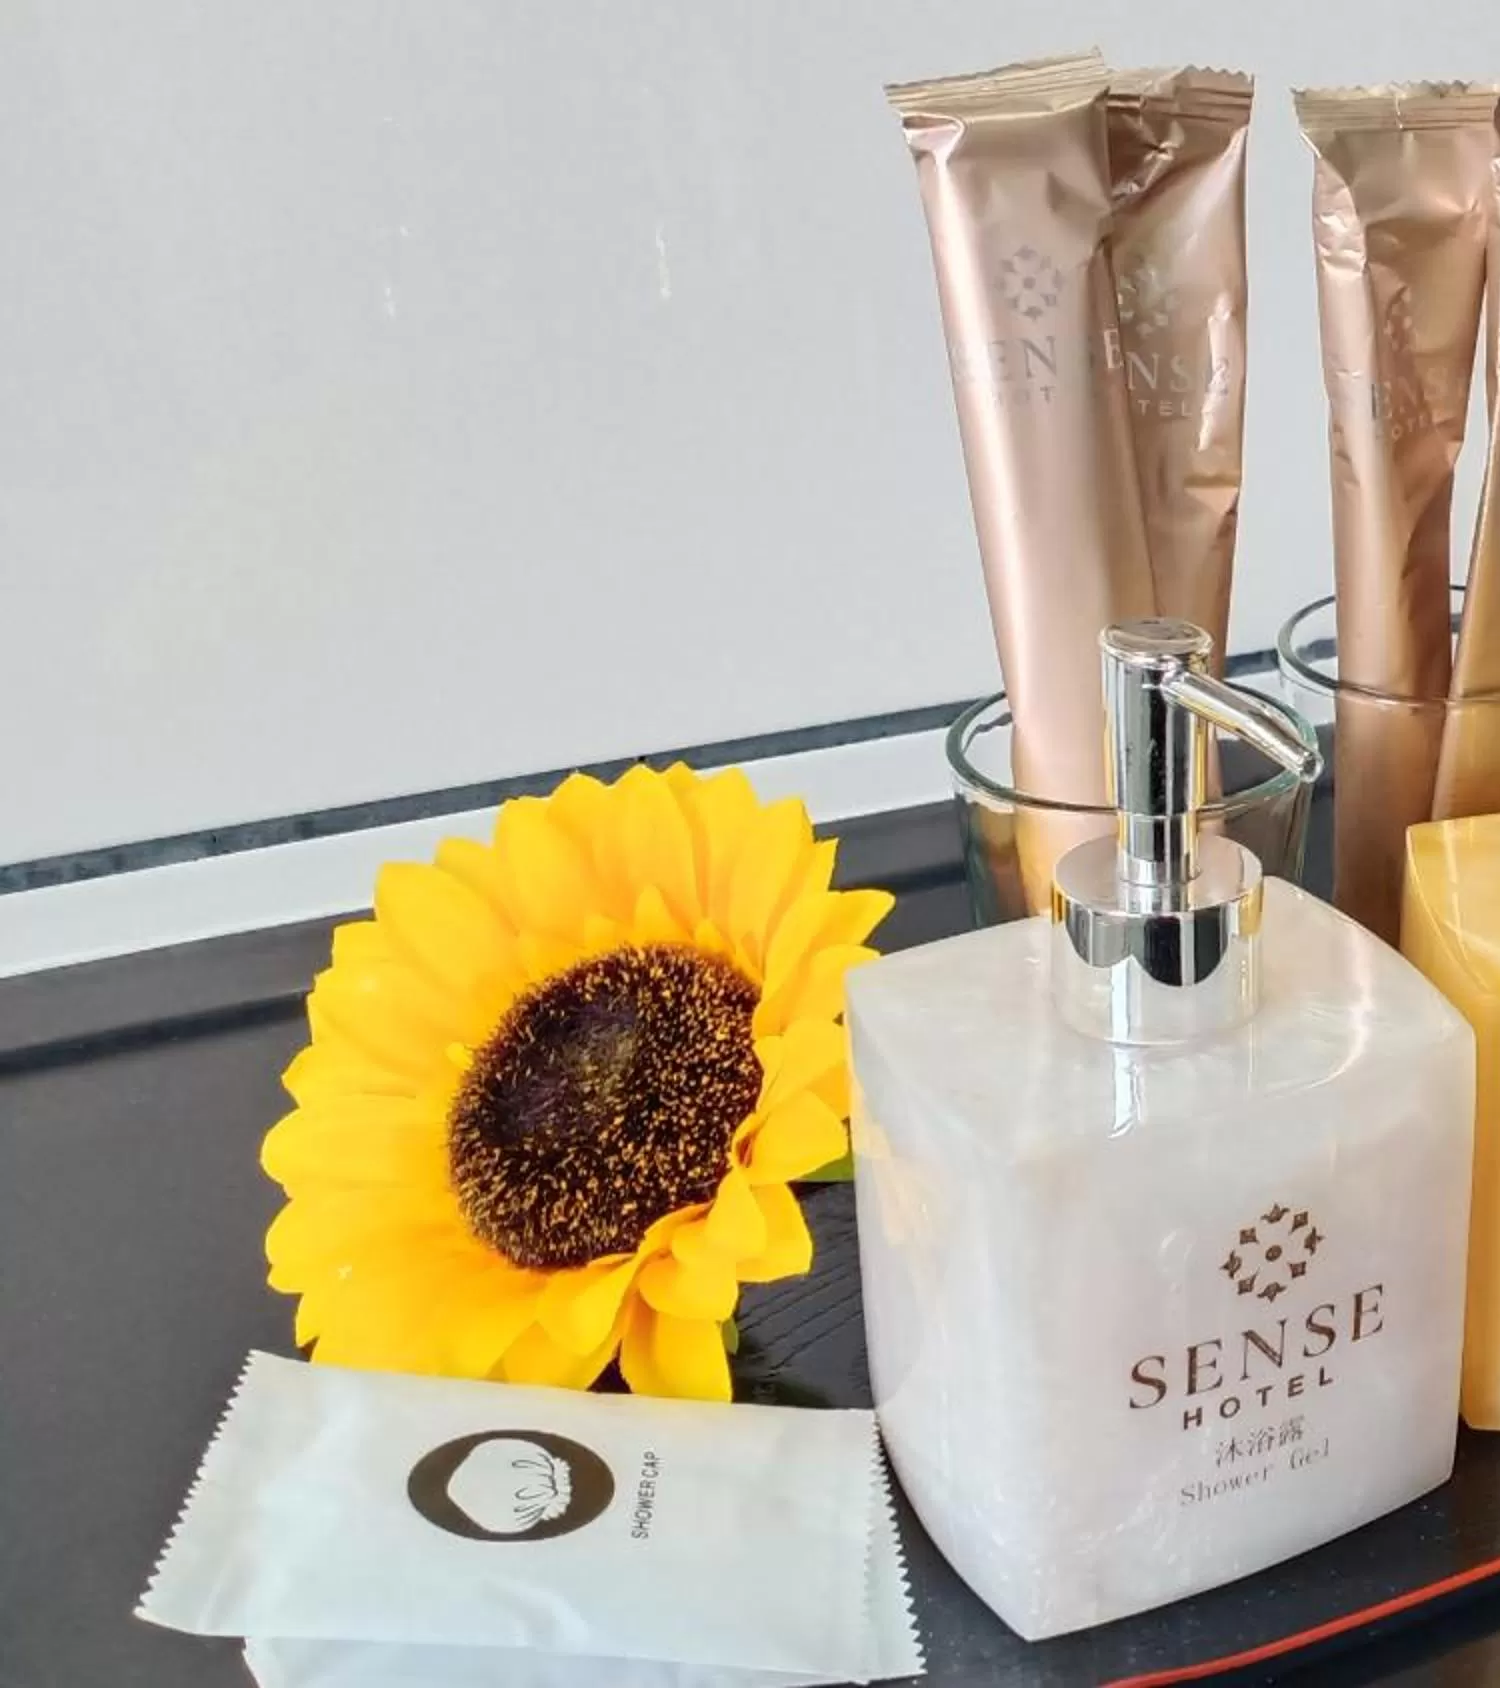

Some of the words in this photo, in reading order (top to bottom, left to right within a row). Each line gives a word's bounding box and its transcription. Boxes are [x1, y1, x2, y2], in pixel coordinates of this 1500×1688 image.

[1128, 1283, 1385, 1410] SENSE
[1182, 1365, 1333, 1431] HOTEL
[640, 1450, 663, 1478] CAP
[1179, 1464, 1270, 1505] Shower
[1288, 1437, 1331, 1471] Gel
[1214, 1414, 1306, 1468] 沐浴露
[631, 1479, 657, 1540] SHOWER
